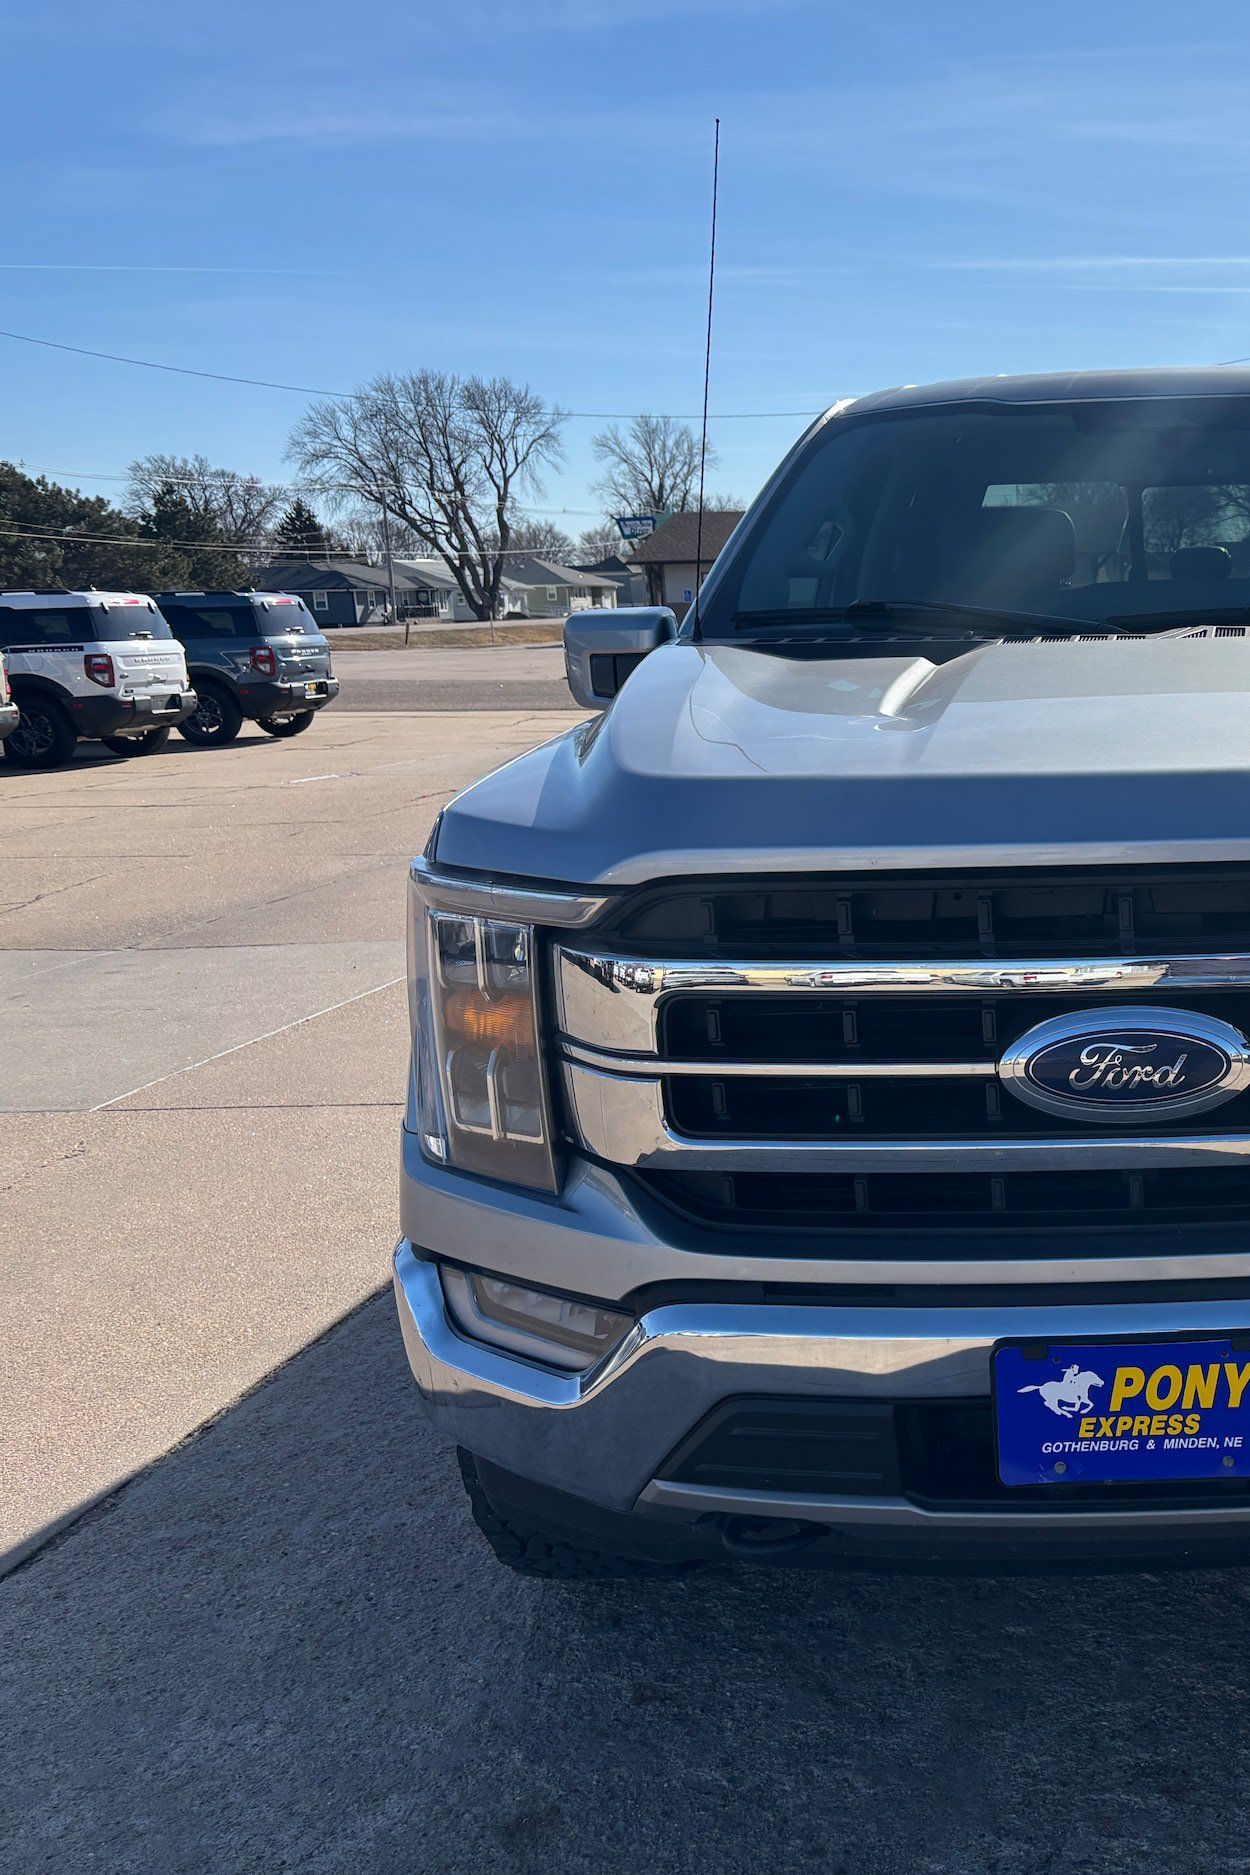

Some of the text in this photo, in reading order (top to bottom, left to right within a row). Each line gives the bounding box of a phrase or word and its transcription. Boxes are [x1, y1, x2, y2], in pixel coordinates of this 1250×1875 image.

[1069, 1043, 1187, 1090] Ford
[1078, 1413, 1202, 1438] EXPRESS
[1041, 1436, 1243, 1453] GOTHENBURG & MINDEN, NE
